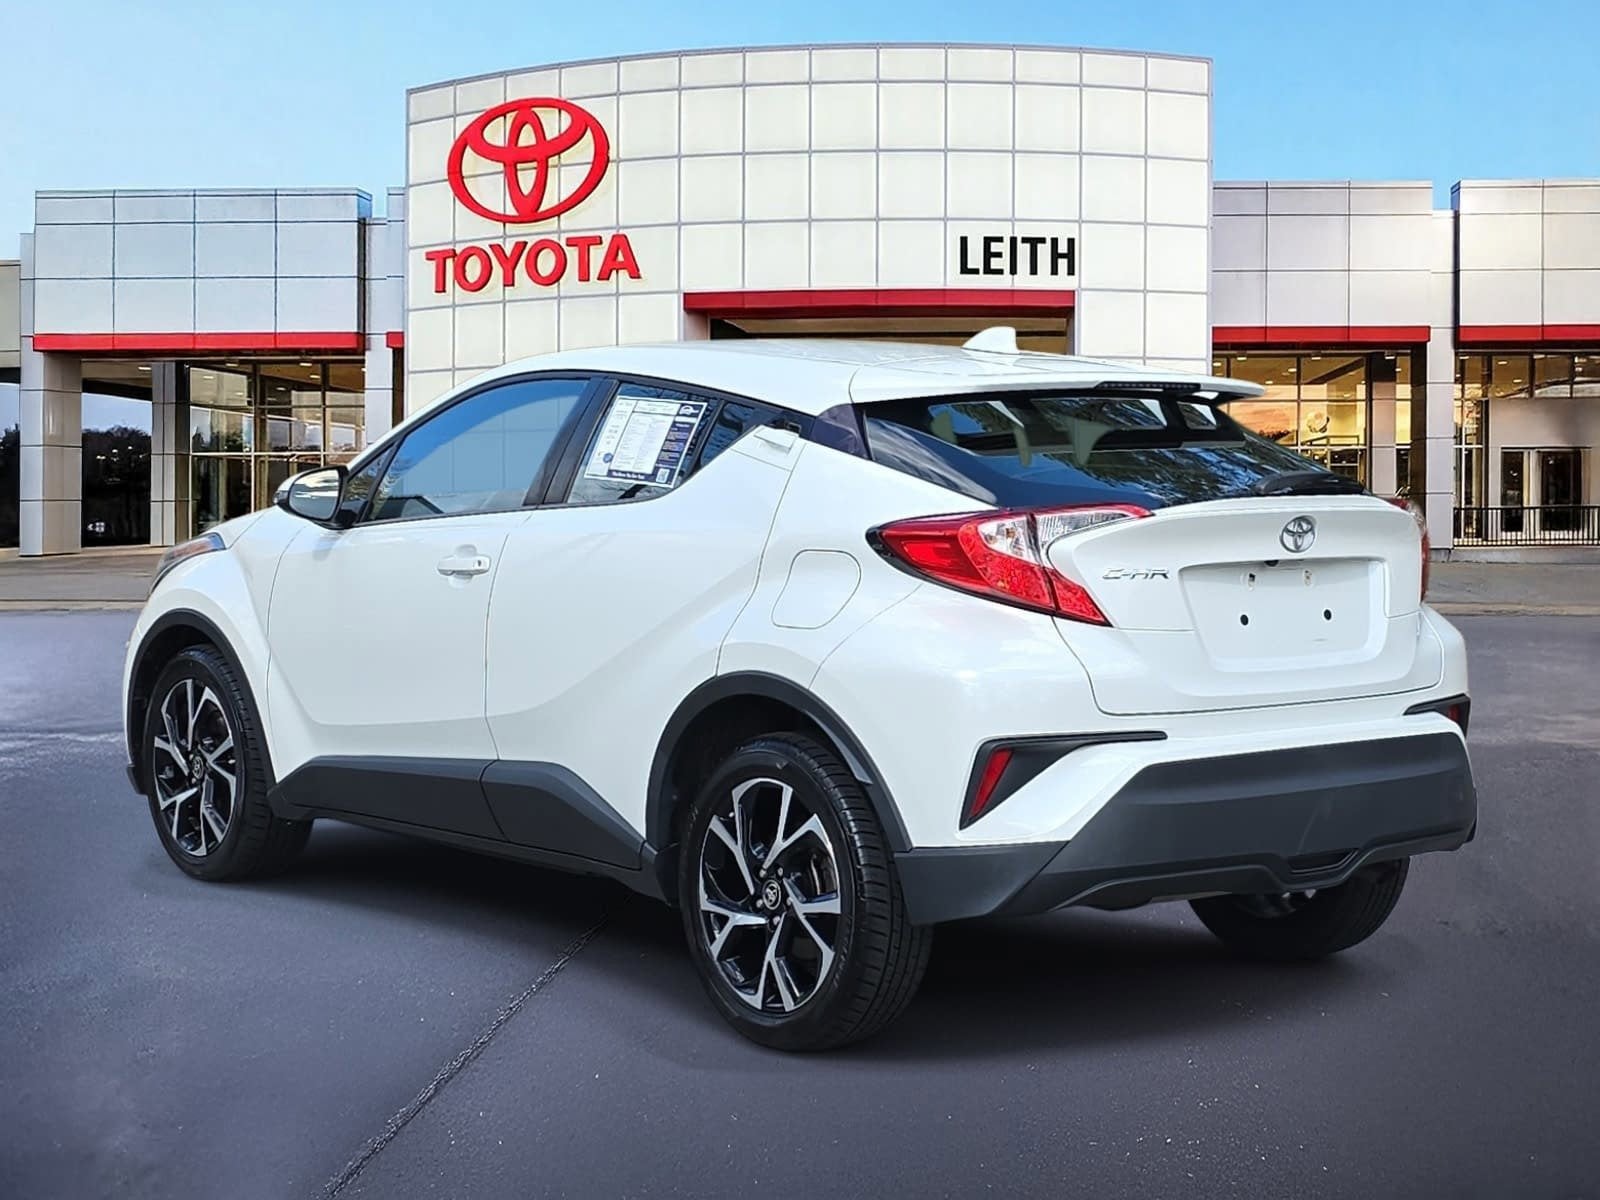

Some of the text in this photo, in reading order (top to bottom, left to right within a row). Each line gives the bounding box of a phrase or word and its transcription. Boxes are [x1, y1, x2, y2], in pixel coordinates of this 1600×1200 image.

[425, 234, 641, 293] TOYOTA
[959, 236, 1075, 276] LEITH
[1102, 568, 1169, 580] C-HR
